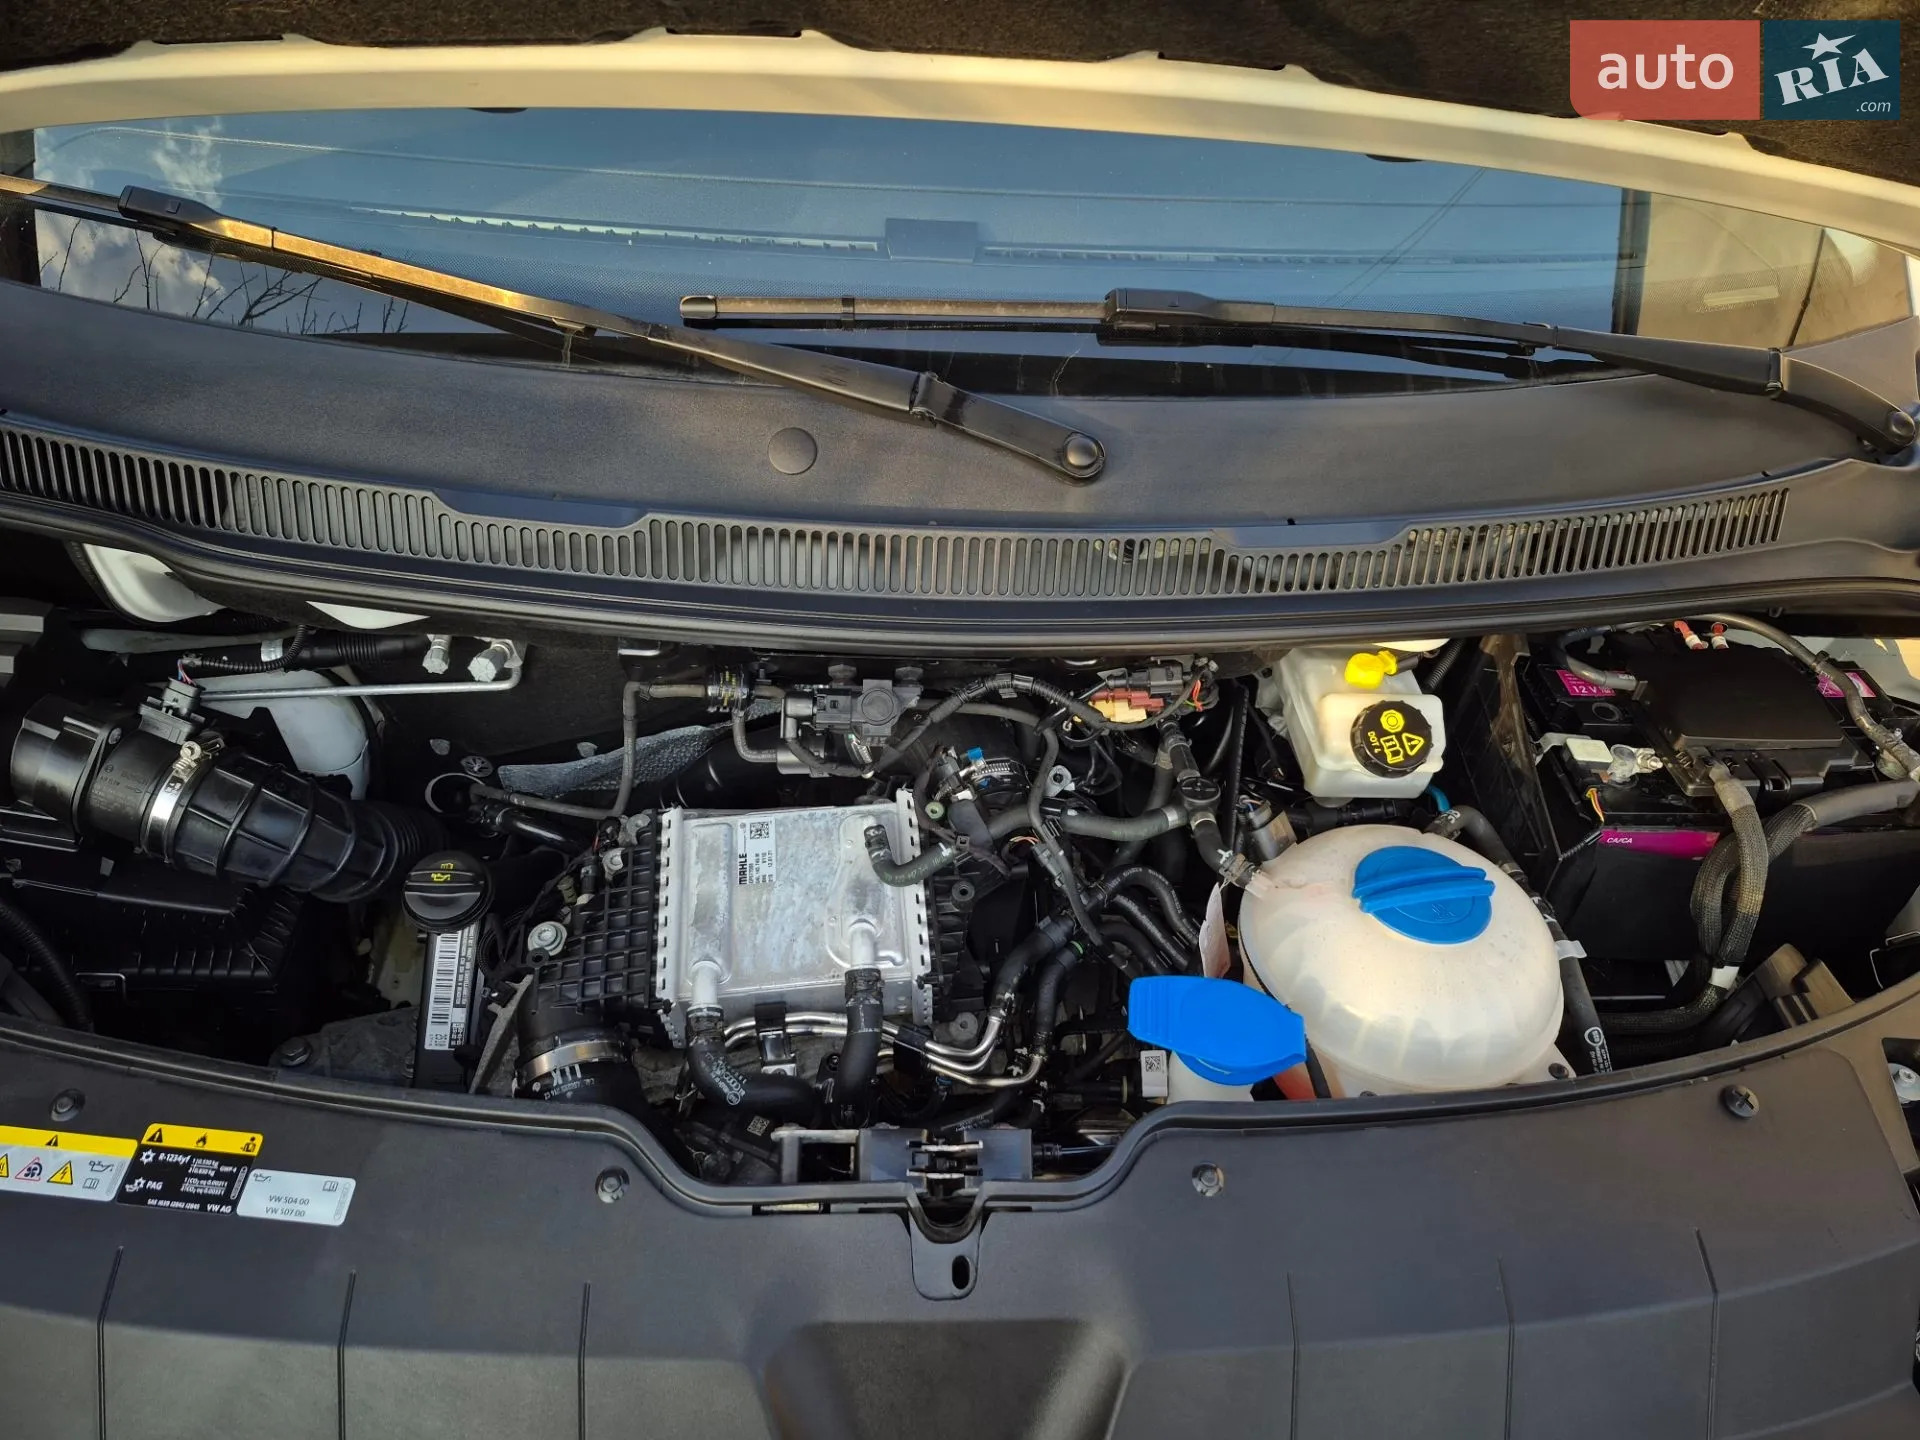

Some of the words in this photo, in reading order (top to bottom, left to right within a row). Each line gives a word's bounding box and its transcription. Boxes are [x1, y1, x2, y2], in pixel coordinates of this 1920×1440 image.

[1367, 731, 1380, 747] DOT
[738, 853, 748, 885] MAHLE
[158, 1152, 192, 1166] R-1234yf
[146, 1181, 164, 1190] PAG
[269, 1195, 282, 1203] VW
[283, 1196, 298, 1205] 504
[299, 1197, 310, 1206] 00
[206, 1203, 220, 1212] VW
[219, 1204, 232, 1214] AG
[265, 1206, 279, 1215] VW
[280, 1207, 294, 1216] 507
[295, 1209, 306, 1217] 00
